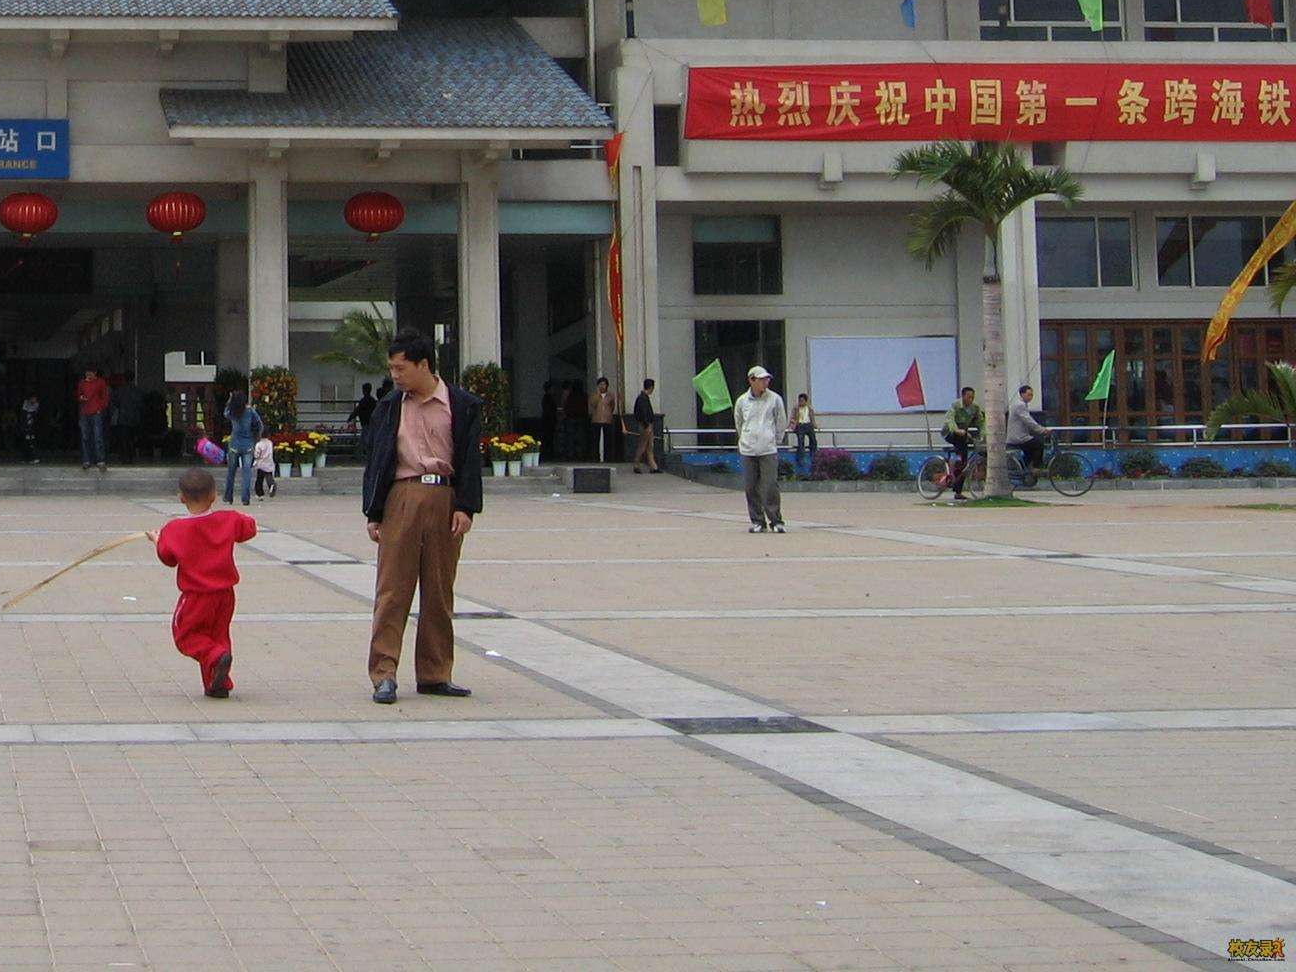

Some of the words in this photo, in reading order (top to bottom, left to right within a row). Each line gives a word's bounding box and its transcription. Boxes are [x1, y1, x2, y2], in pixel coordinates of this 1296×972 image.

[729, 77, 1291, 127] 热烈庆祝中国第一条跨海铁
